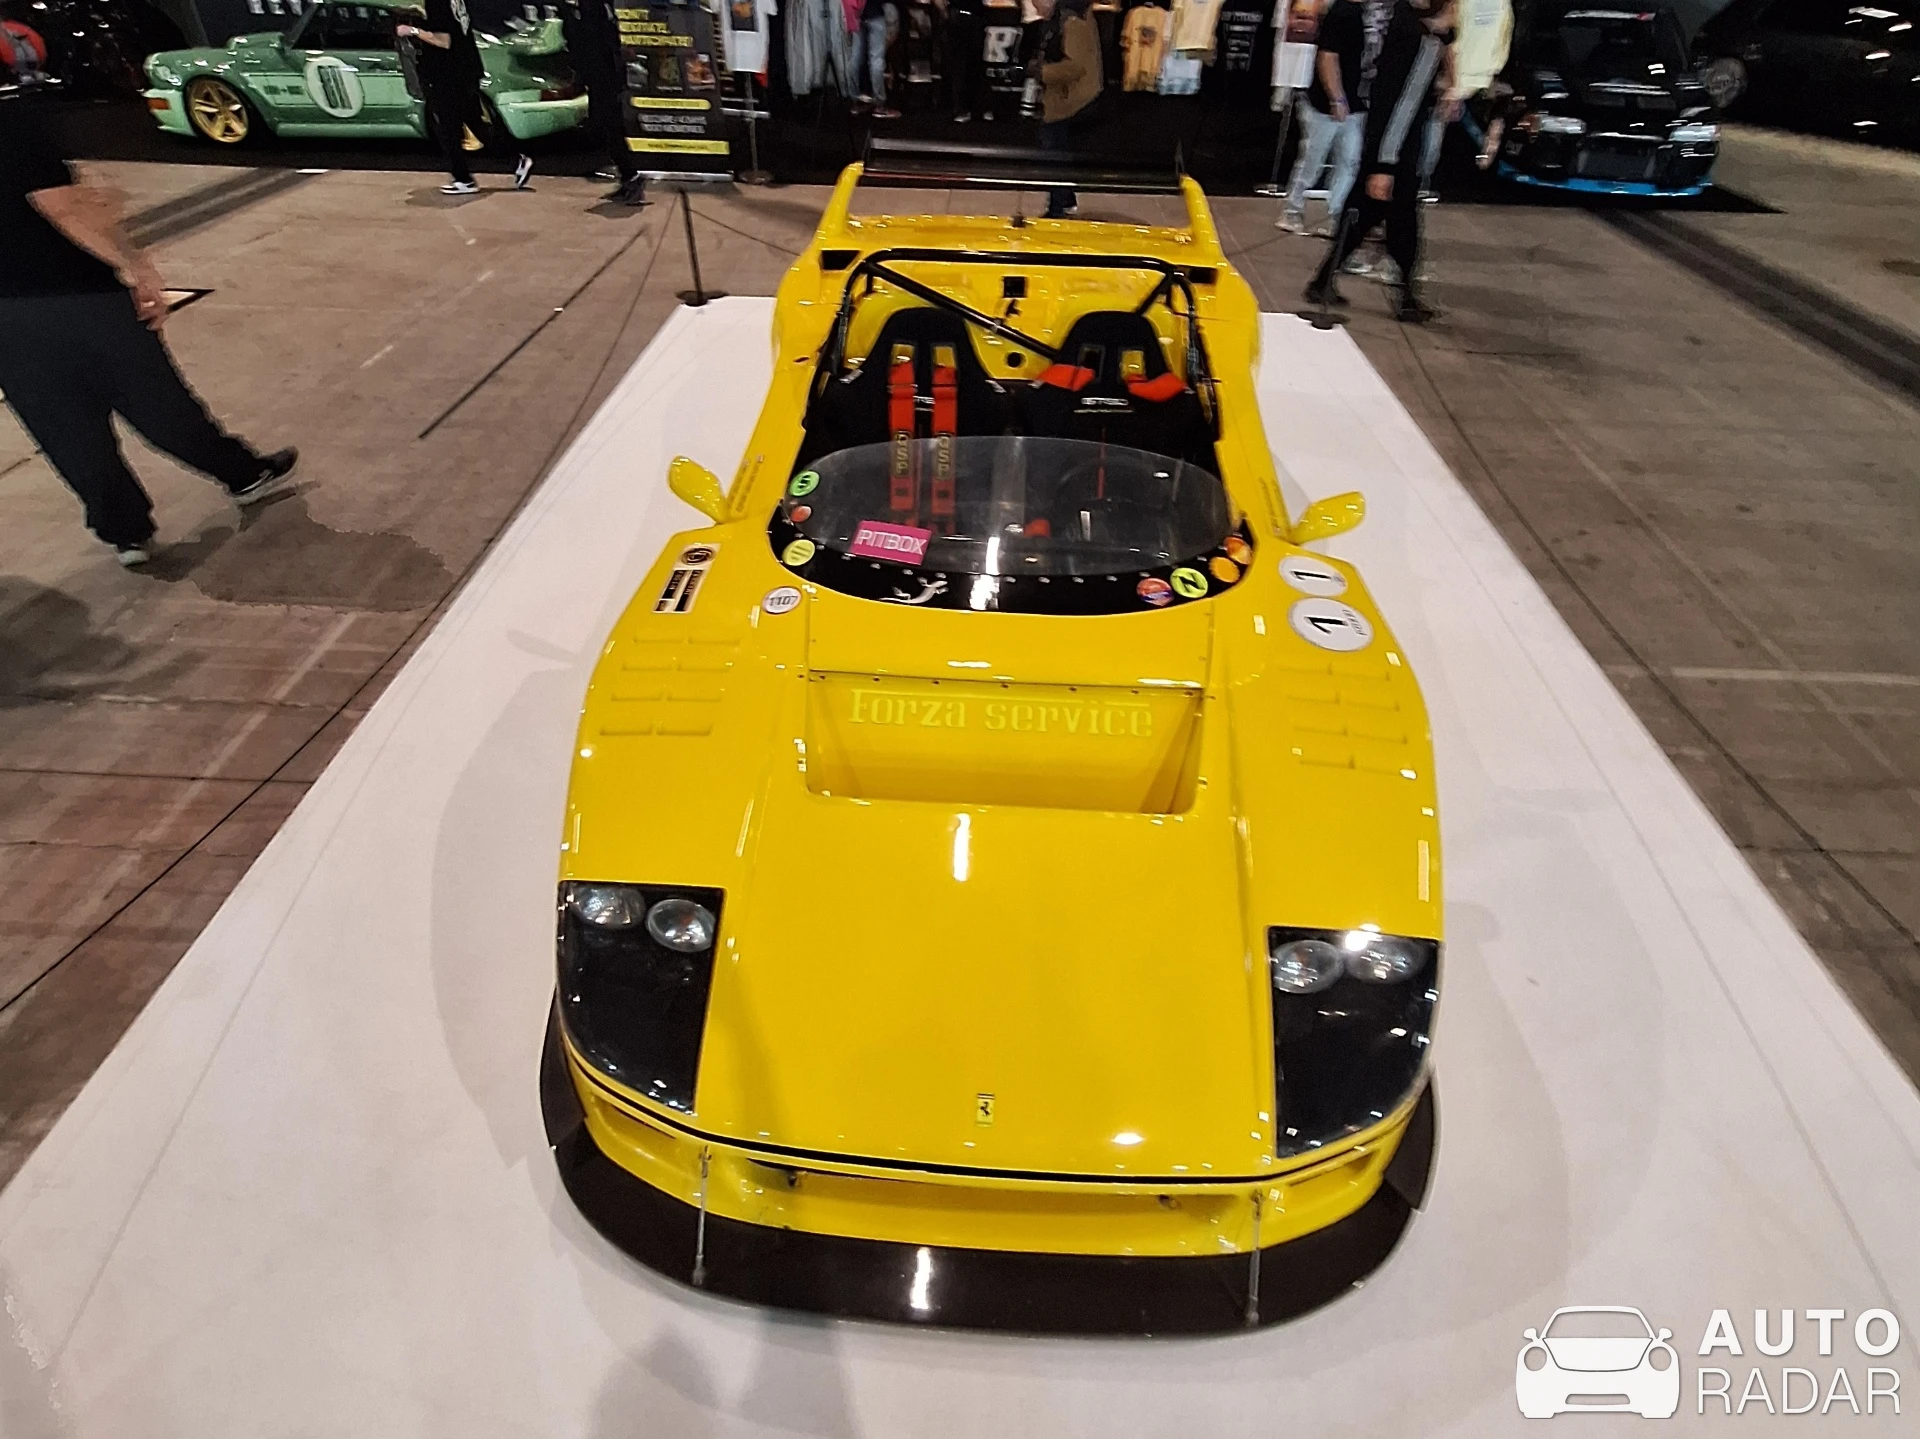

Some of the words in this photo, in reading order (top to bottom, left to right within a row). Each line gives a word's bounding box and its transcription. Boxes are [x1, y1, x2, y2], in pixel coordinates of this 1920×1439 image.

[854, 529, 928, 555] PITBOX
[769, 595, 799, 607] 1107
[1304, 616, 1348, 634] 1
[848, 689, 966, 727] Forza
[985, 701, 1152, 737] service
